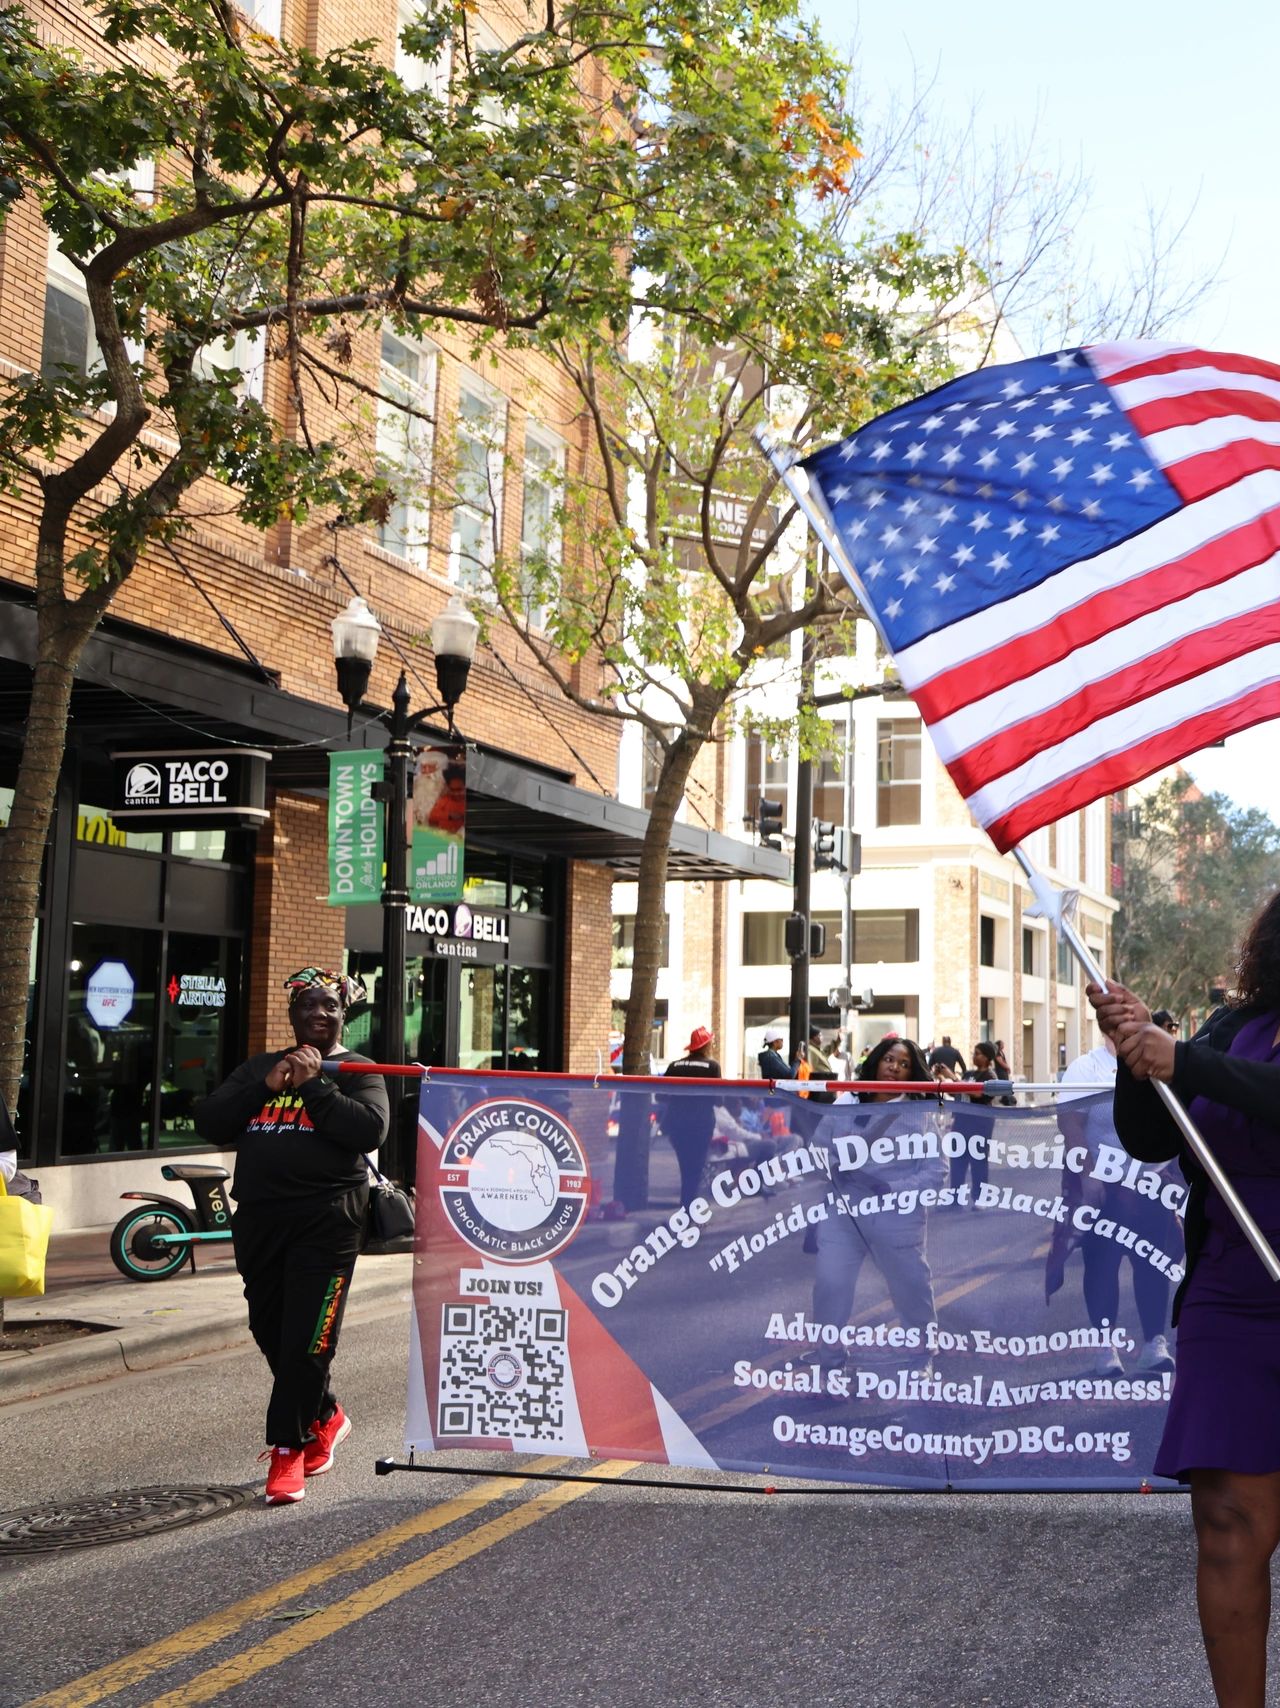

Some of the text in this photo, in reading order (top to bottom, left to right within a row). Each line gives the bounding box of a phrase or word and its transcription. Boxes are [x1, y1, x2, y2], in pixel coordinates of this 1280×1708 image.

[718, 522, 767, 540] ORAGE
[165, 760, 229, 783] TACO
[125, 796, 160, 805] cantina
[168, 782, 227, 804] BELL
[360, 763, 377, 858] HOLIDAYS
[335, 765, 354, 893] DOWNTOWN
[416, 880, 457, 889] ORLANDO
[405, 904, 509, 943] TACO BELL
[436, 942, 478, 958] cantina
[180, 974, 227, 992] STELLA
[102, 998, 117, 1007] UFC
[178, 990, 226, 1007] ARTOIS
[453, 1110, 576, 1164] ORANGE COUNTY
[447, 1174, 461, 1182] EST
[566, 1179, 582, 1189] 1983
[208, 1187, 227, 1224] veo
[481, 1193, 528, 1201] AWARENESS
[453, 1198, 574, 1251] DEMOCRATIC BLACK CAUCUS
[591, 1196, 713, 1308] Orange
[711, 1141, 833, 1209] County
[832, 1129, 1088, 1173] Democratic
[843, 1184, 973, 1218] Largest
[974, 1182, 1069, 1223] Black
[1072, 1204, 1186, 1283] Caucus
[466, 1278, 543, 1296] JOIN US!
[764, 1312, 1135, 1357] Advocates for Economic,
[733, 1360, 1172, 1407] Social & Political Awareness!
[772, 1415, 1131, 1465] OrangeCountyDBC.org
